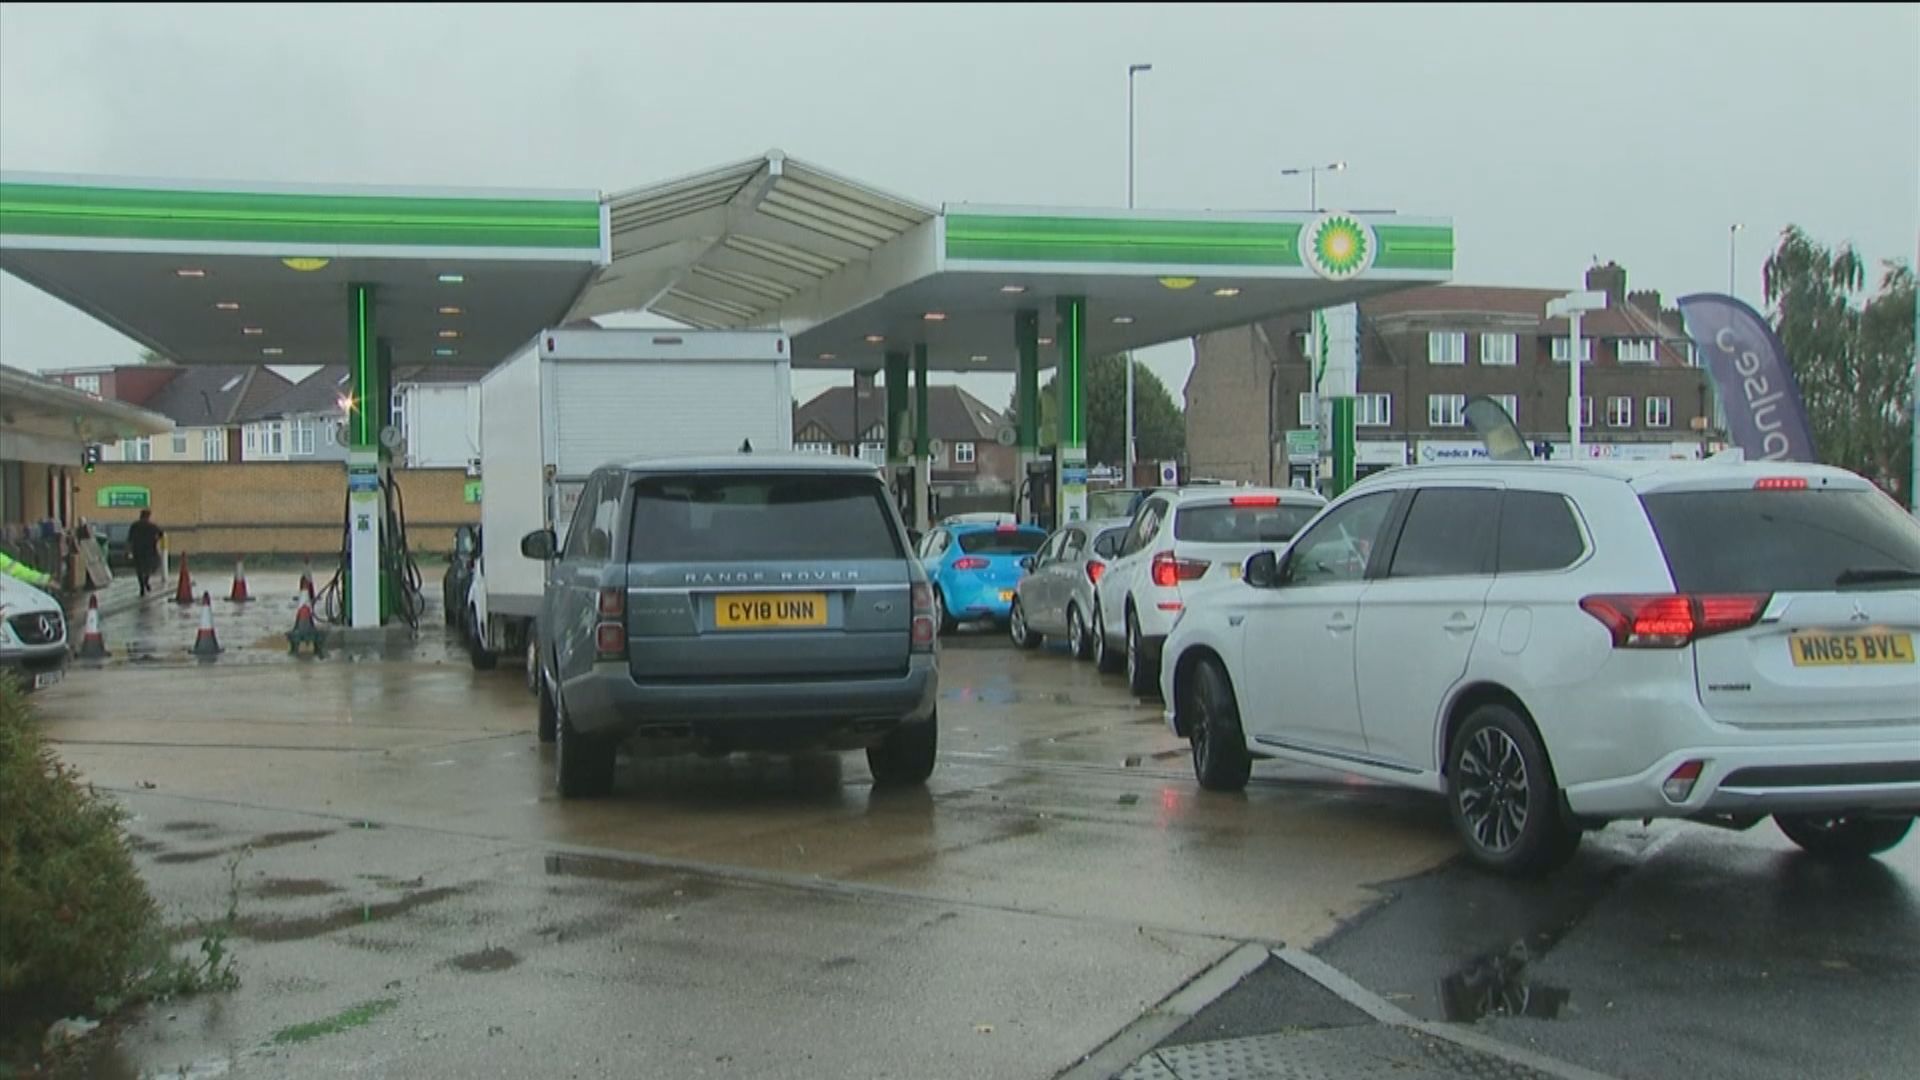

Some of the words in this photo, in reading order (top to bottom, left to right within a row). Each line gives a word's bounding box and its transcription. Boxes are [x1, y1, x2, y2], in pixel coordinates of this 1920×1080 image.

[685, 572, 764, 583] RANGE
[781, 571, 858, 580] ROVER
[728, 601, 771, 621] CY18
[777, 600, 814, 619] UNN
[1800, 635, 1857, 661] WN65
[1861, 634, 1905, 658] BVL
